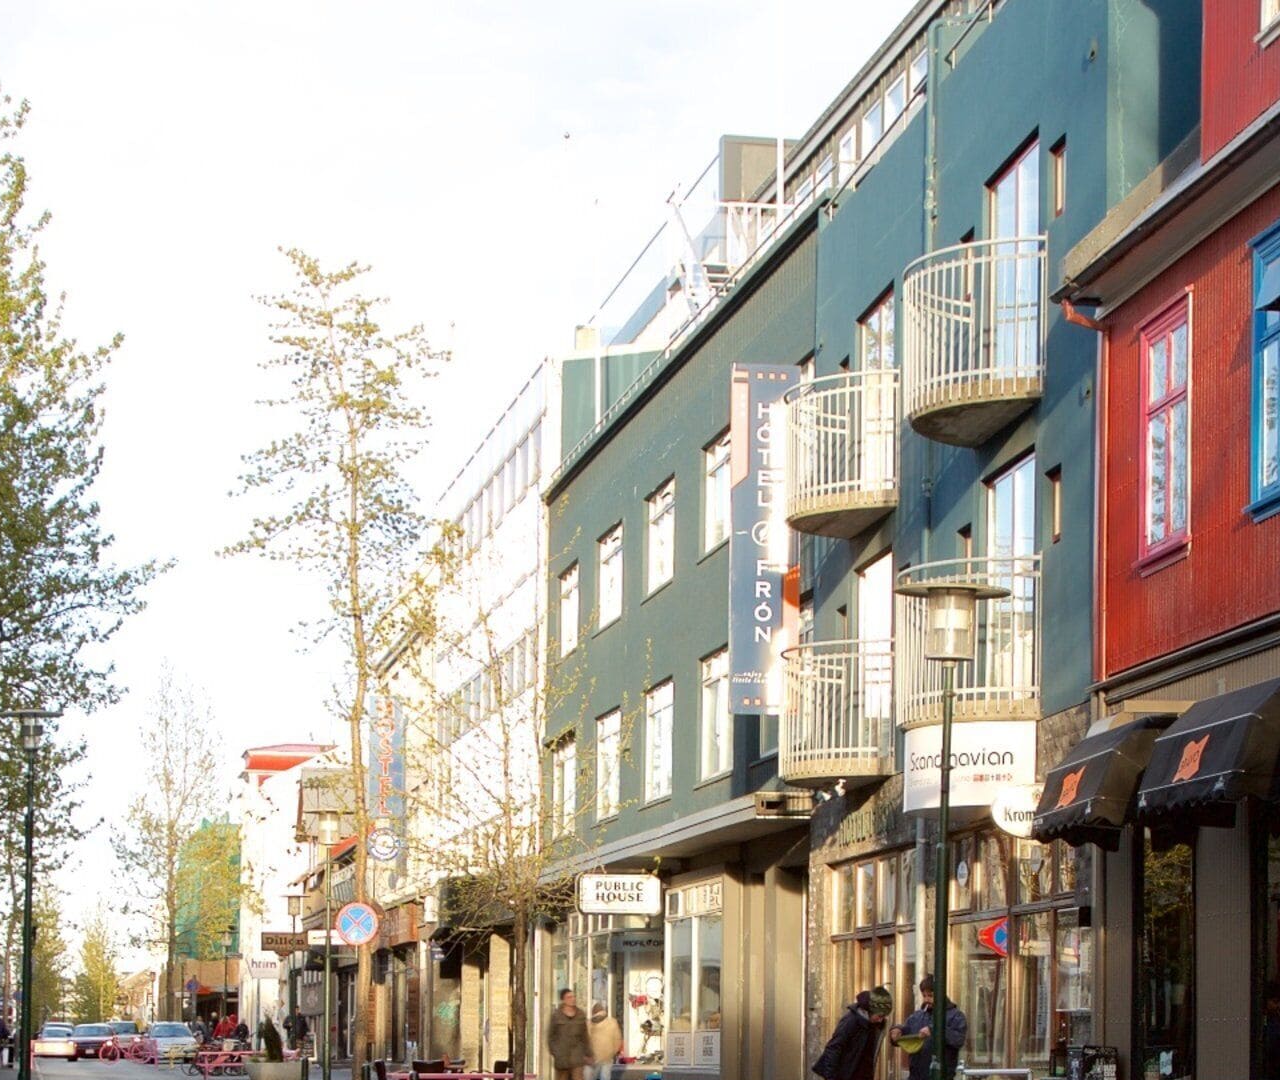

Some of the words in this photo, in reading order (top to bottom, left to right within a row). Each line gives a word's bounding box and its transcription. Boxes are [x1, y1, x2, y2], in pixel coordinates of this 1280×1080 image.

[754, 560, 772, 642] FRÓN
[595, 880, 645, 891] PUBLIC
[596, 891, 645, 903] HOUSE
